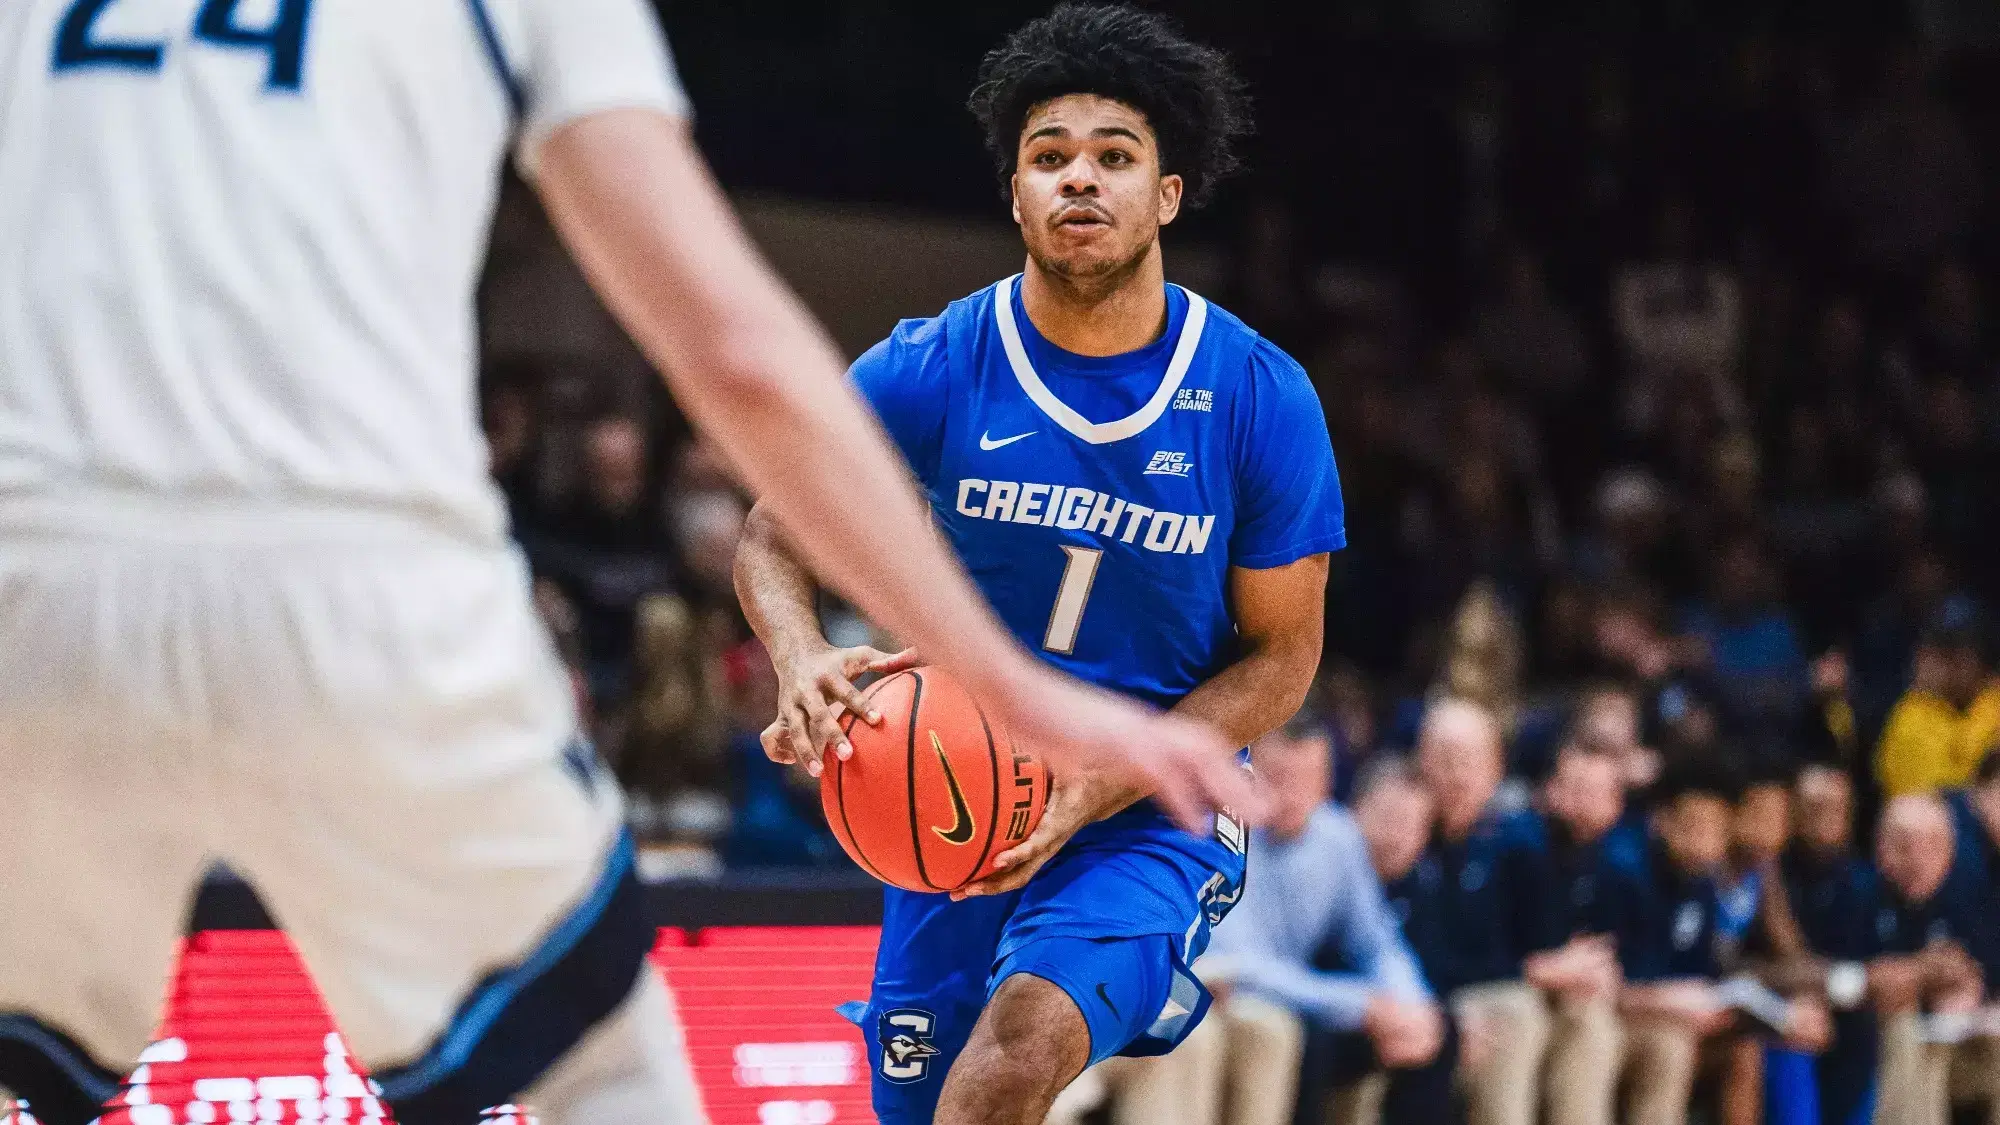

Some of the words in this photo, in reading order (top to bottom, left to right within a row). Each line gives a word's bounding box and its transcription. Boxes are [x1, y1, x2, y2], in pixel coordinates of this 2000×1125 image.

[1177, 389, 1193, 399] BE
[1195, 389, 1213, 402] THE
[1172, 399, 1213, 412] CHANGE
[1151, 451, 1186, 463] BIG
[1146, 461, 1194, 474] EAST
[956, 478, 1216, 555] CREIGHTON
[1042, 544, 1104, 656] 1
[1004, 743, 1033, 841] ELIT
